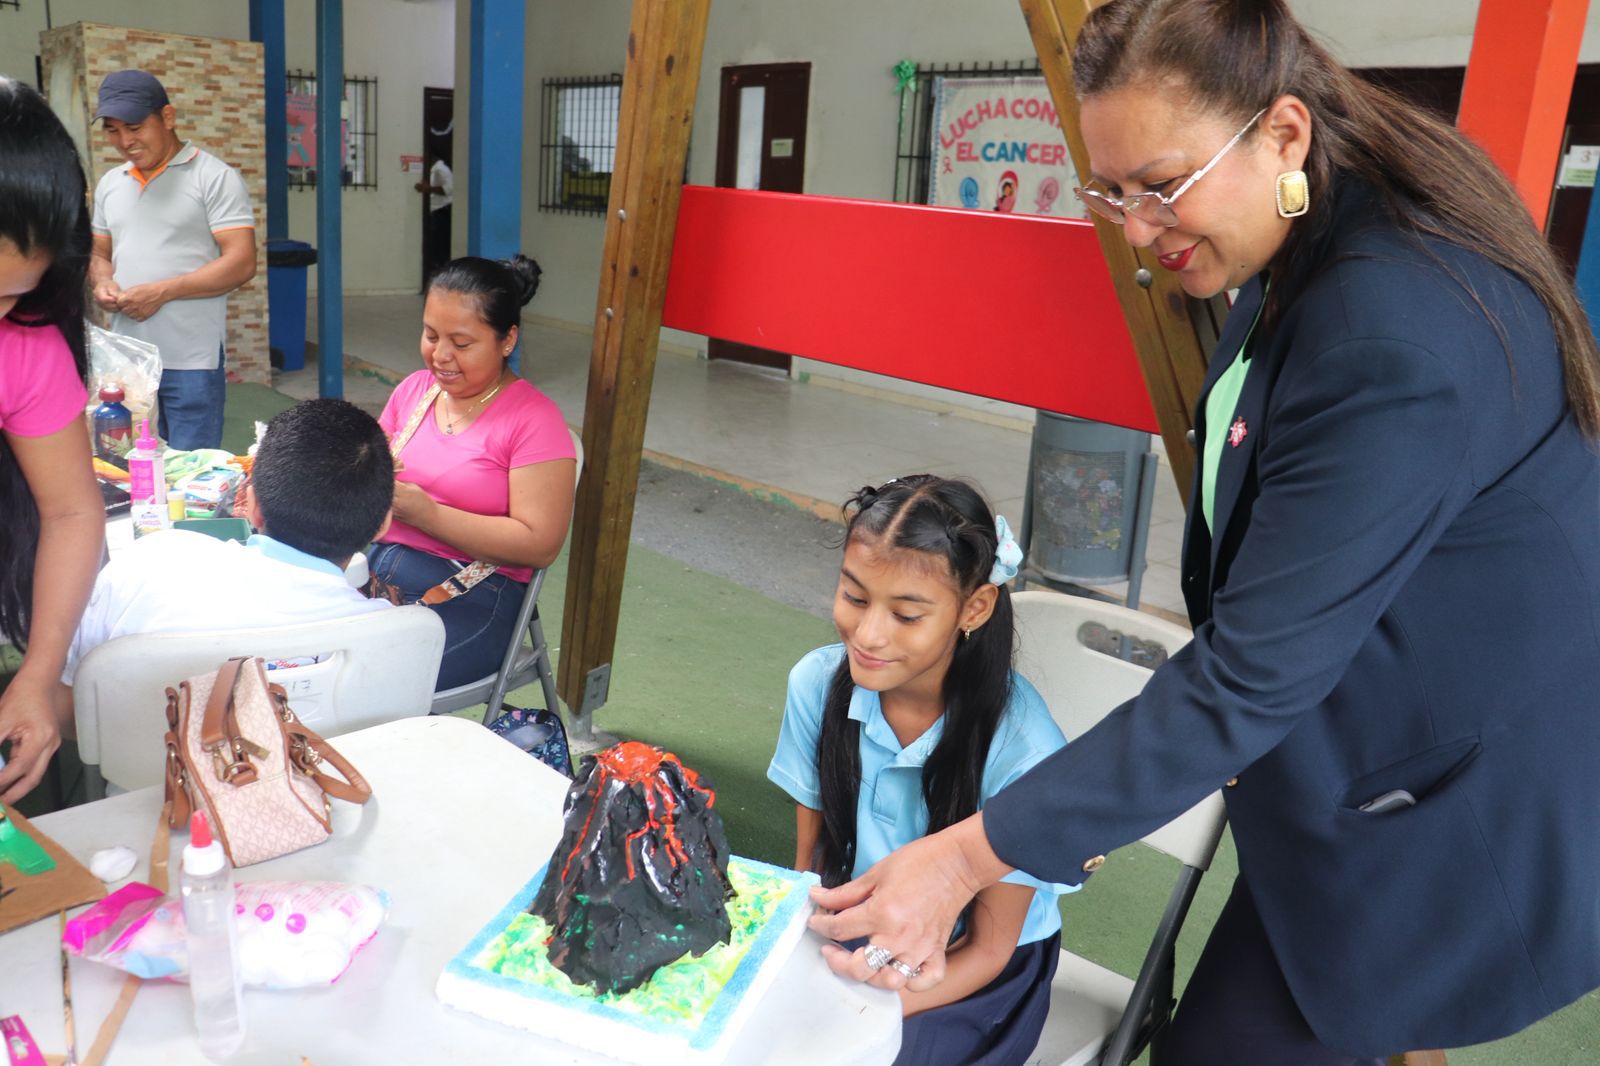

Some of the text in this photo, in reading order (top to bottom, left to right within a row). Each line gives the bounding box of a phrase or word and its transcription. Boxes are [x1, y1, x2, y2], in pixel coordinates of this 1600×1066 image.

[940, 97, 1062, 149] LUCHA CON
[956, 141, 1066, 165] EL CANCER
